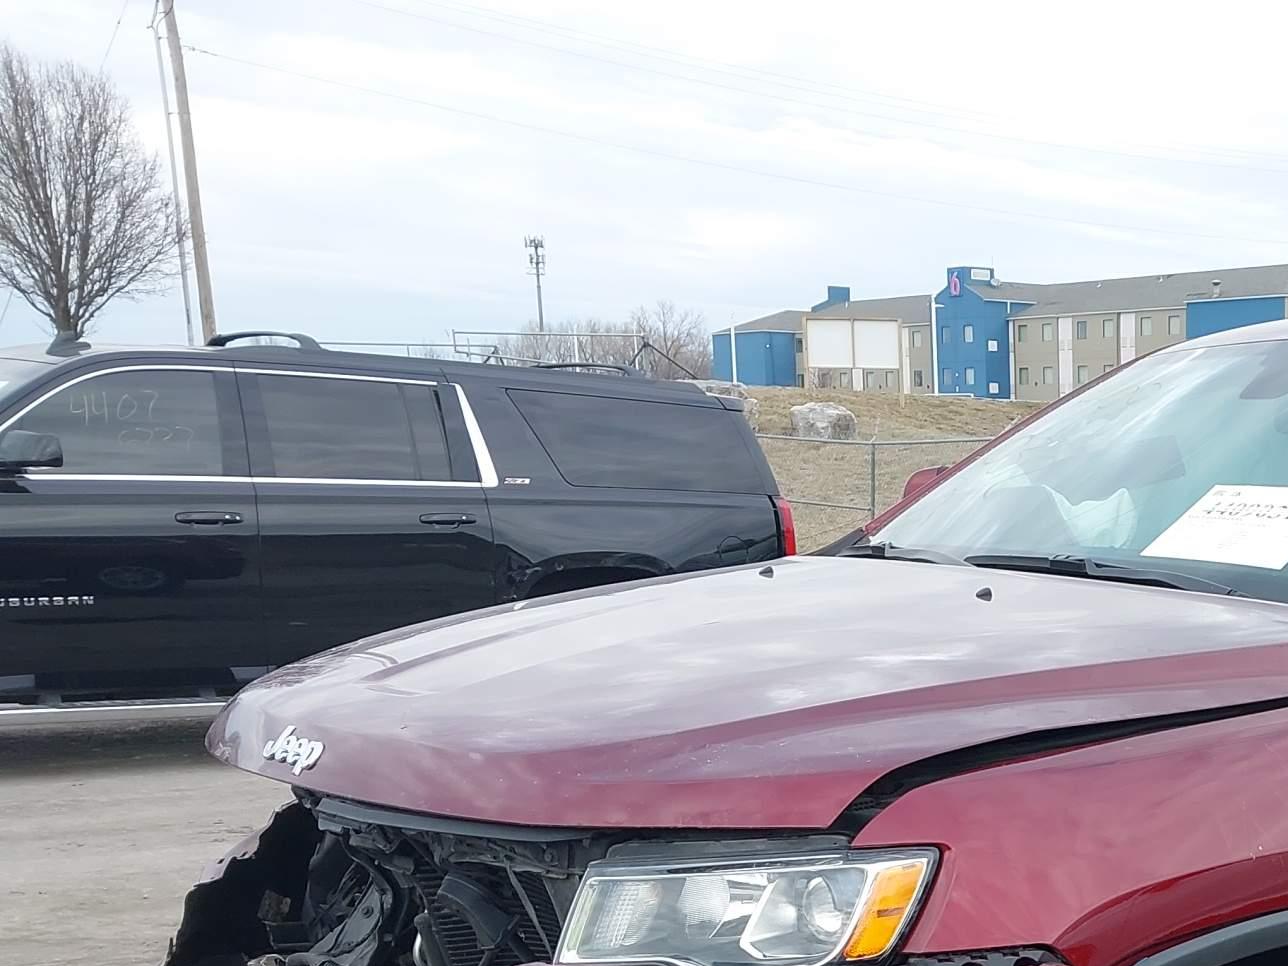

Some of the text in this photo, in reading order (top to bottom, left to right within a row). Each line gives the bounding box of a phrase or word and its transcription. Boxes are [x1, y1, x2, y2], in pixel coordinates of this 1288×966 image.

[949, 271, 961, 297] 6
[69, 390, 159, 426] 4407
[262, 725, 325, 776] Jeep
